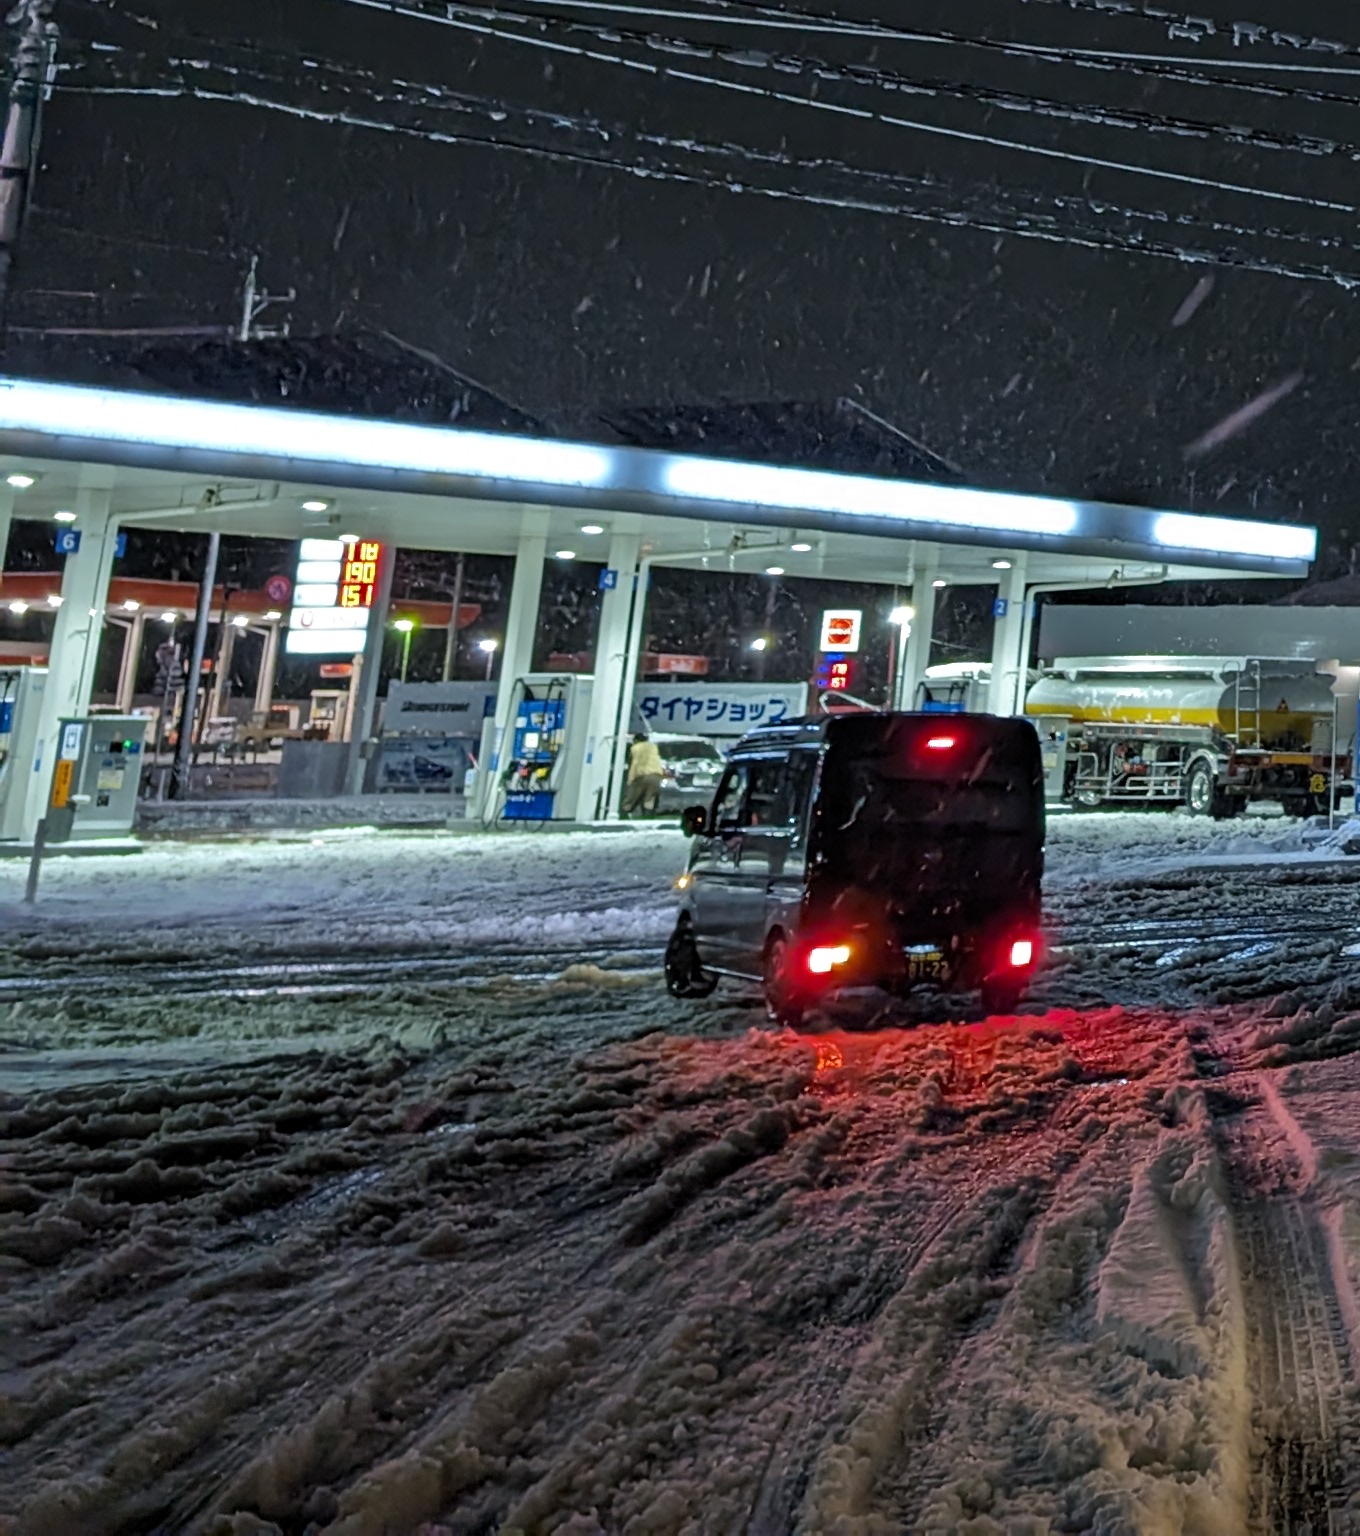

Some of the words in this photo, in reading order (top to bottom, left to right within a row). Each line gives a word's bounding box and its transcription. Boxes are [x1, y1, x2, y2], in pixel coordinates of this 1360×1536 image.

[62, 537, 76, 550] 6
[346, 561, 376, 584] 190
[604, 571, 614, 586] 4
[341, 584, 373, 607] 151
[996, 601, 1005, 614] 2
